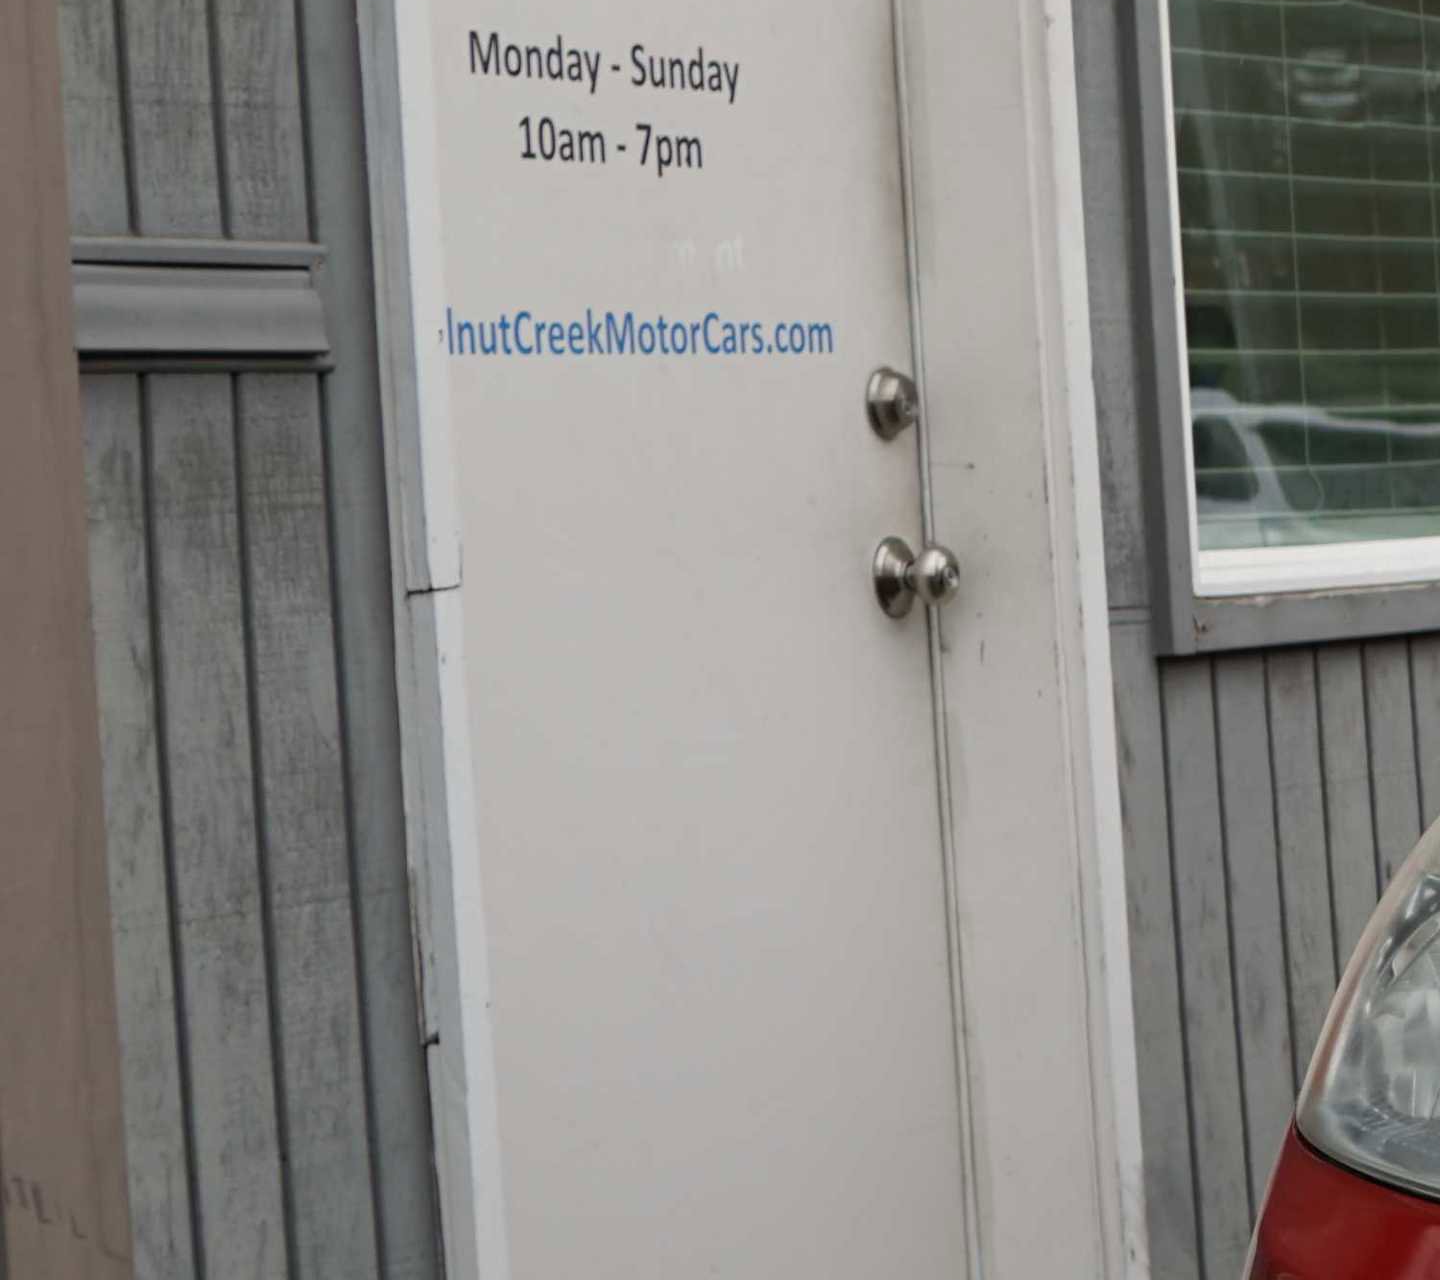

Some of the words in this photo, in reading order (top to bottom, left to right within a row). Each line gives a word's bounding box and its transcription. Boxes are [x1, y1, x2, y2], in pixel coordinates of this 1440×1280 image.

[467, 29, 602, 95] Monday
[630, 43, 740, 105] Sunday
[518, 115, 607, 164] 10am
[634, 122, 704, 178] 7pm
